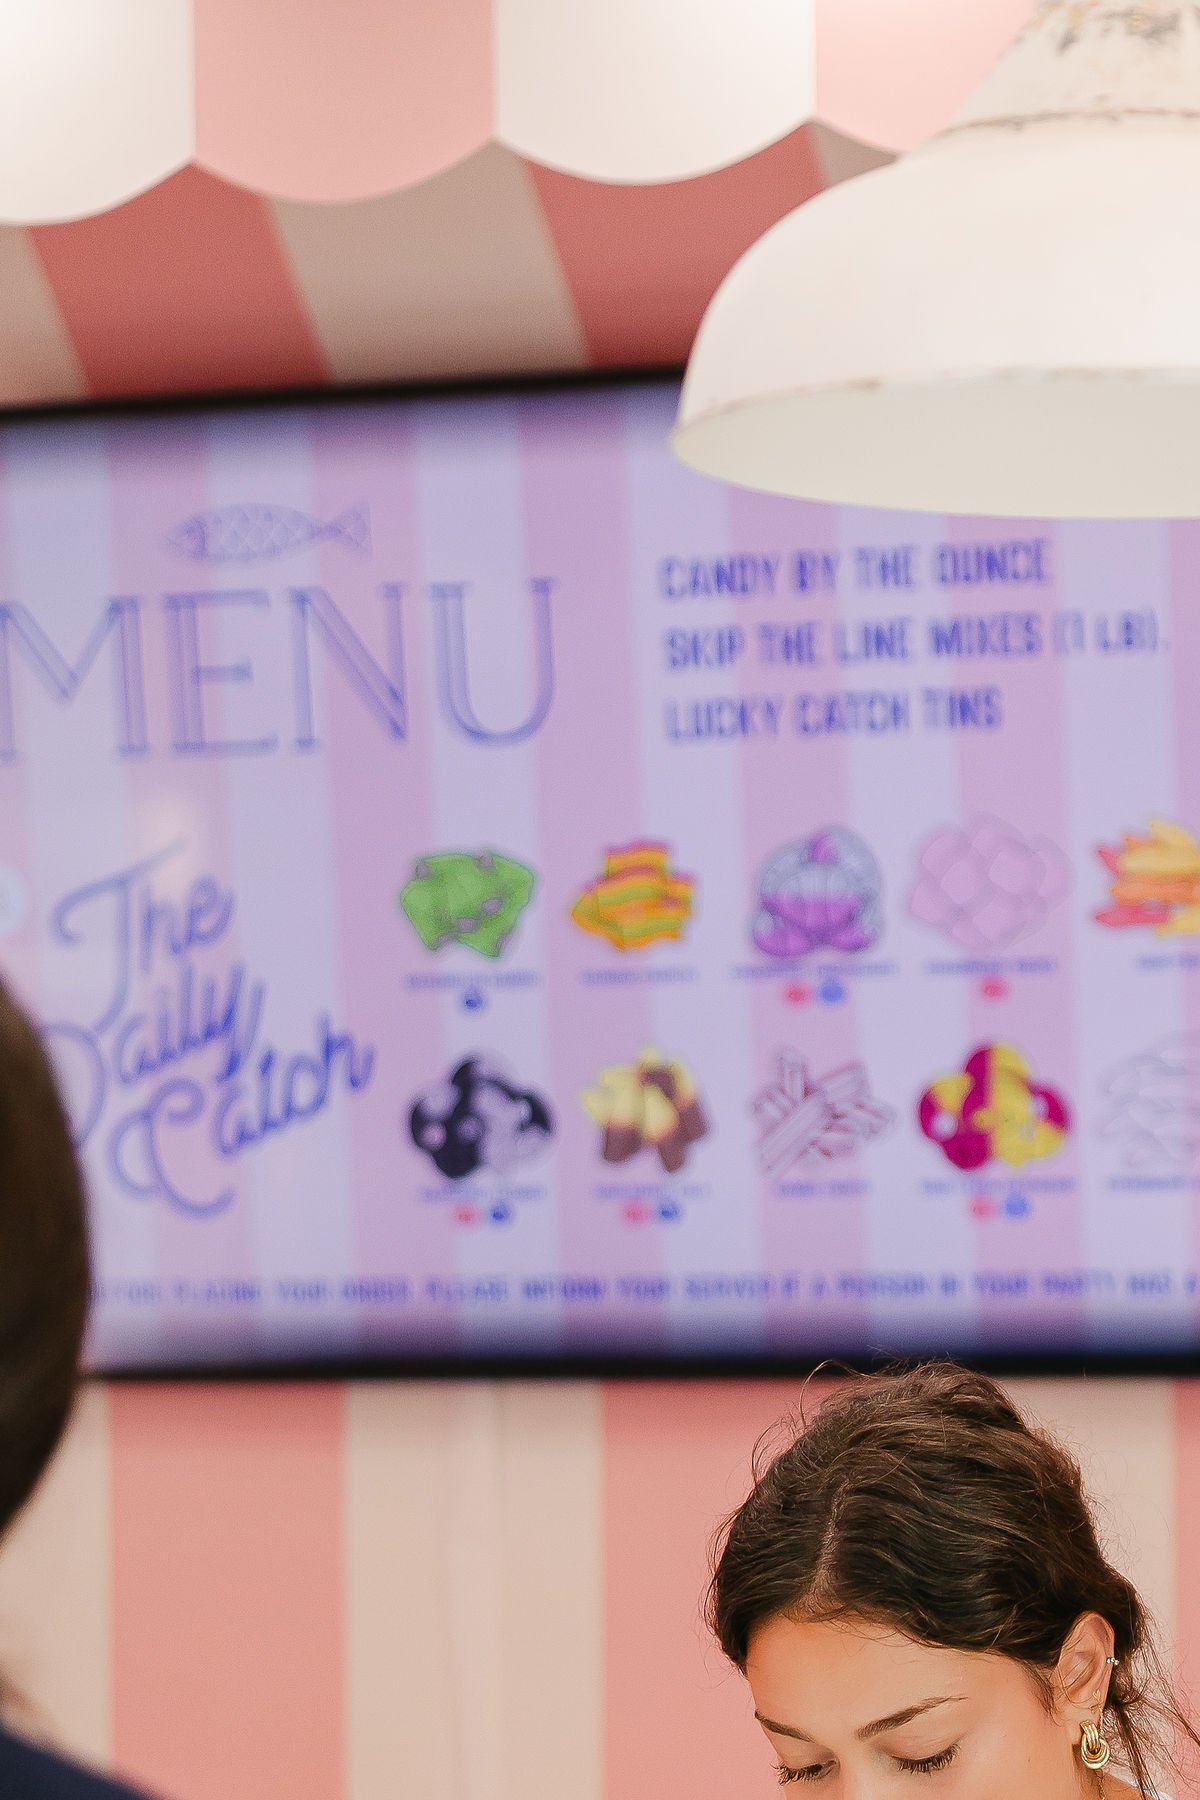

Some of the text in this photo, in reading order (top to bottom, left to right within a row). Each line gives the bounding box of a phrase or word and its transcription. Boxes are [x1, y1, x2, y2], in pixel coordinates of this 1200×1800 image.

[657, 536, 1051, 604] CANDY BY THE OUNCE
[0, 576, 556, 758] MENU
[661, 622, 746, 675] SKIP
[755, 619, 822, 672] THE
[832, 615, 913, 668] LINE
[925, 610, 1044, 662] MIXES
[663, 683, 1004, 747] LUCKY CATCH TINS
[50, 837, 238, 1035] The
[105, 1010, 378, 1220] Catch
